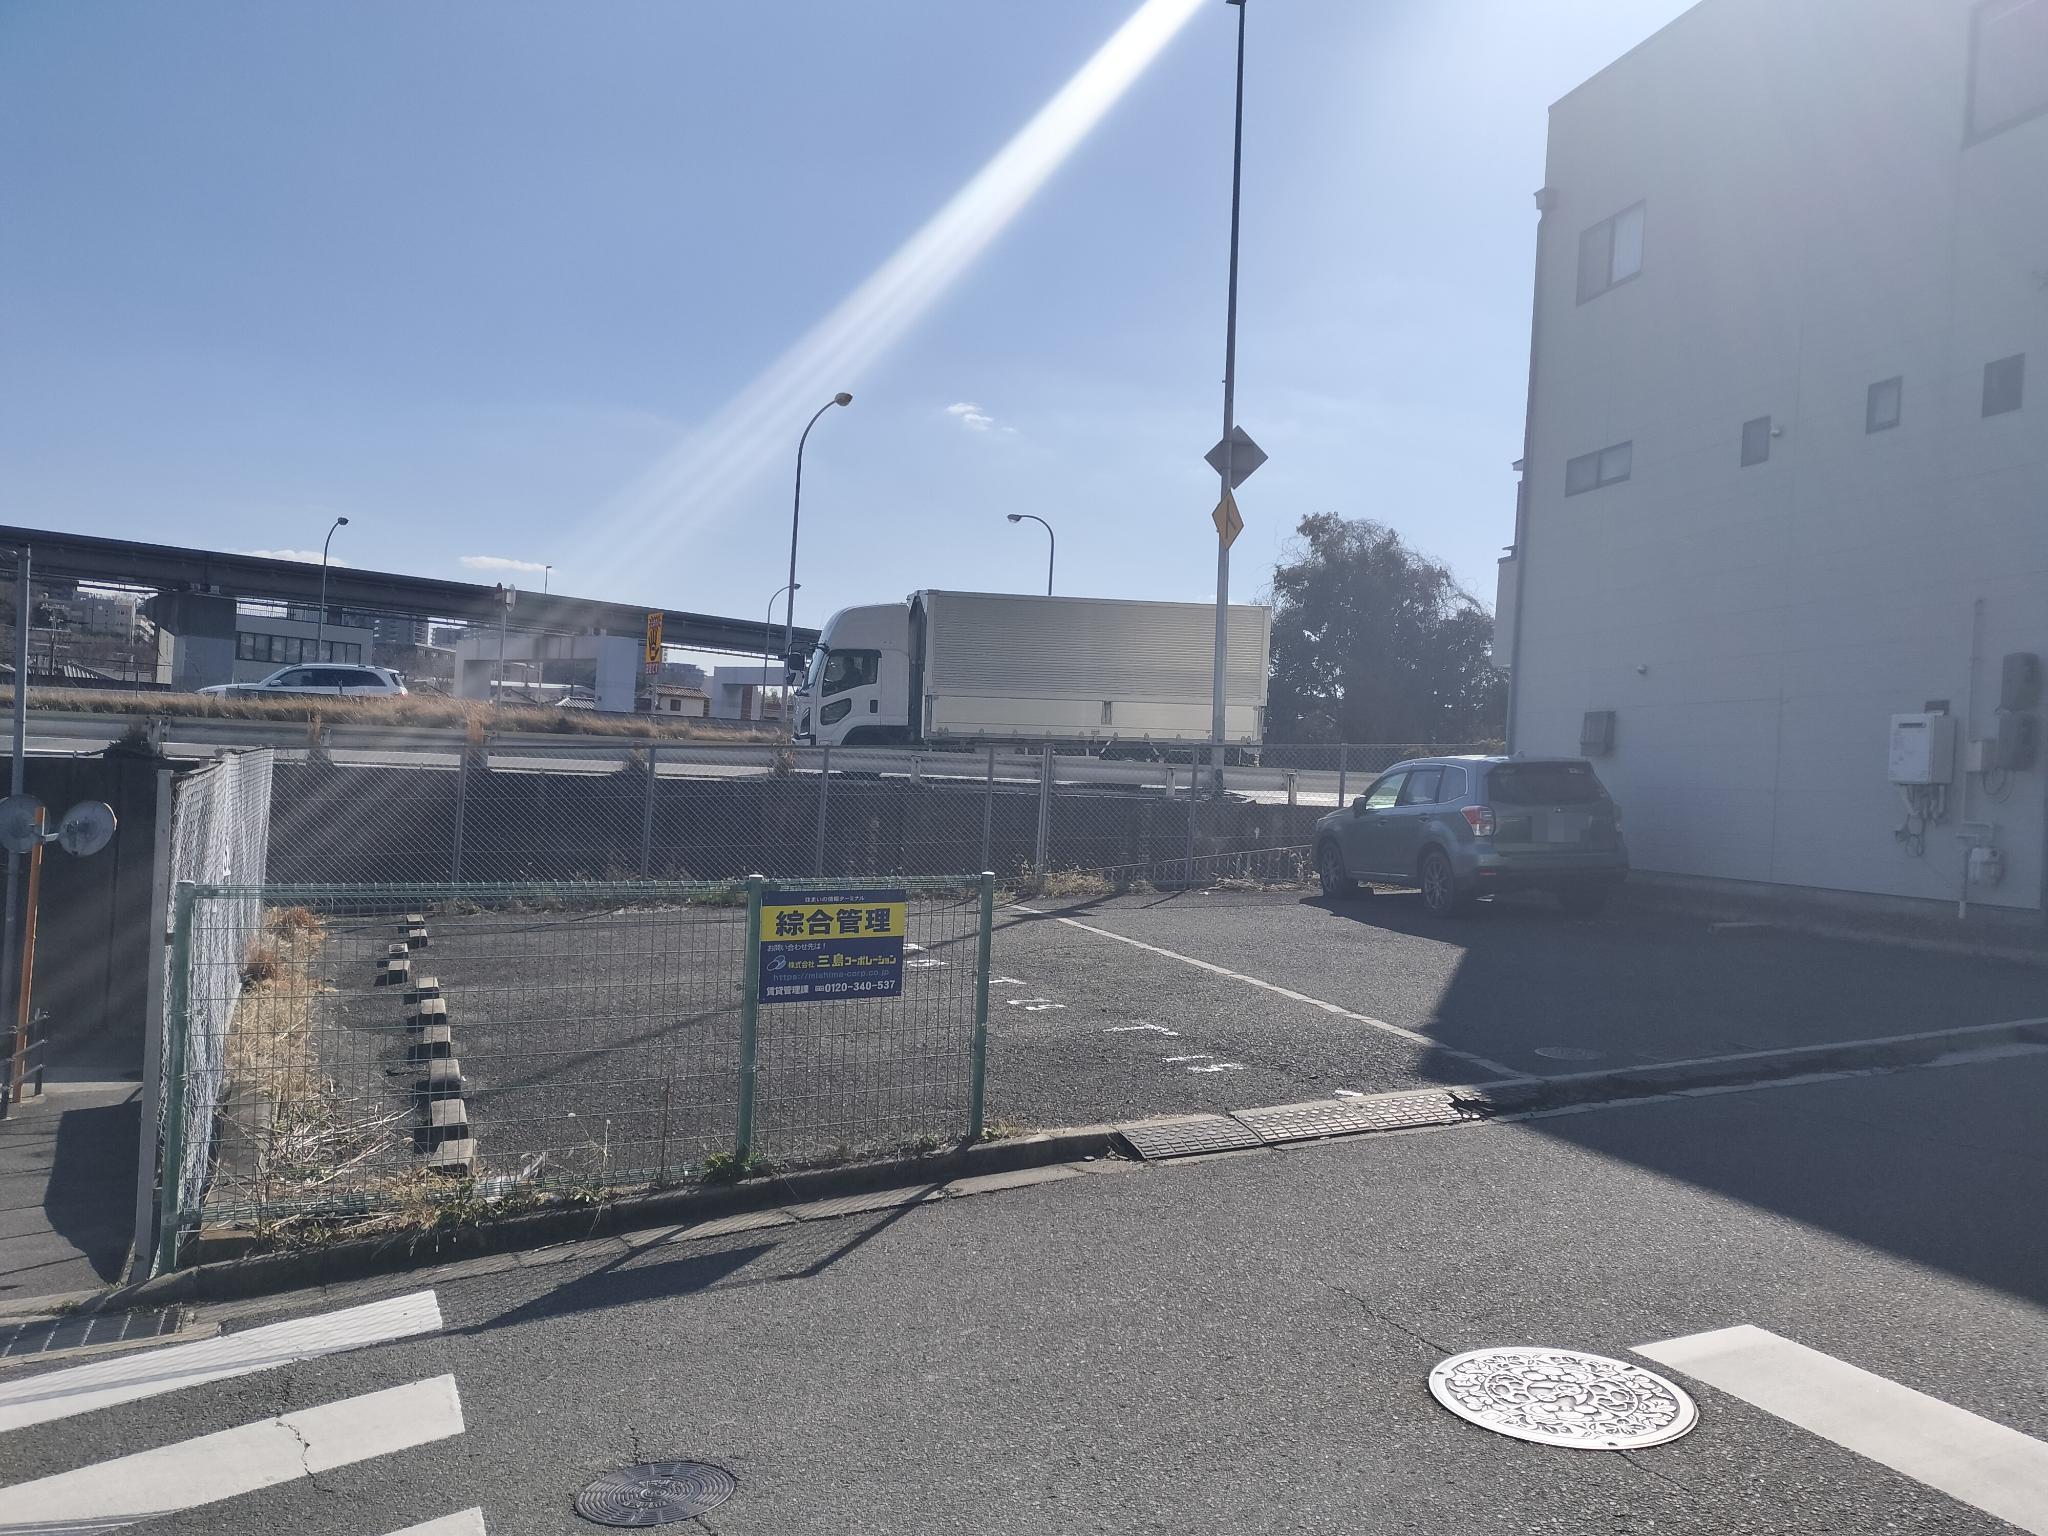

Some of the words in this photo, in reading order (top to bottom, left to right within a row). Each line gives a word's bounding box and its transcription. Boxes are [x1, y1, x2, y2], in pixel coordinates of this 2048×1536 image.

[776, 908, 890, 936] 綜合管理
[825, 980, 896, 993] 0120-340-537
